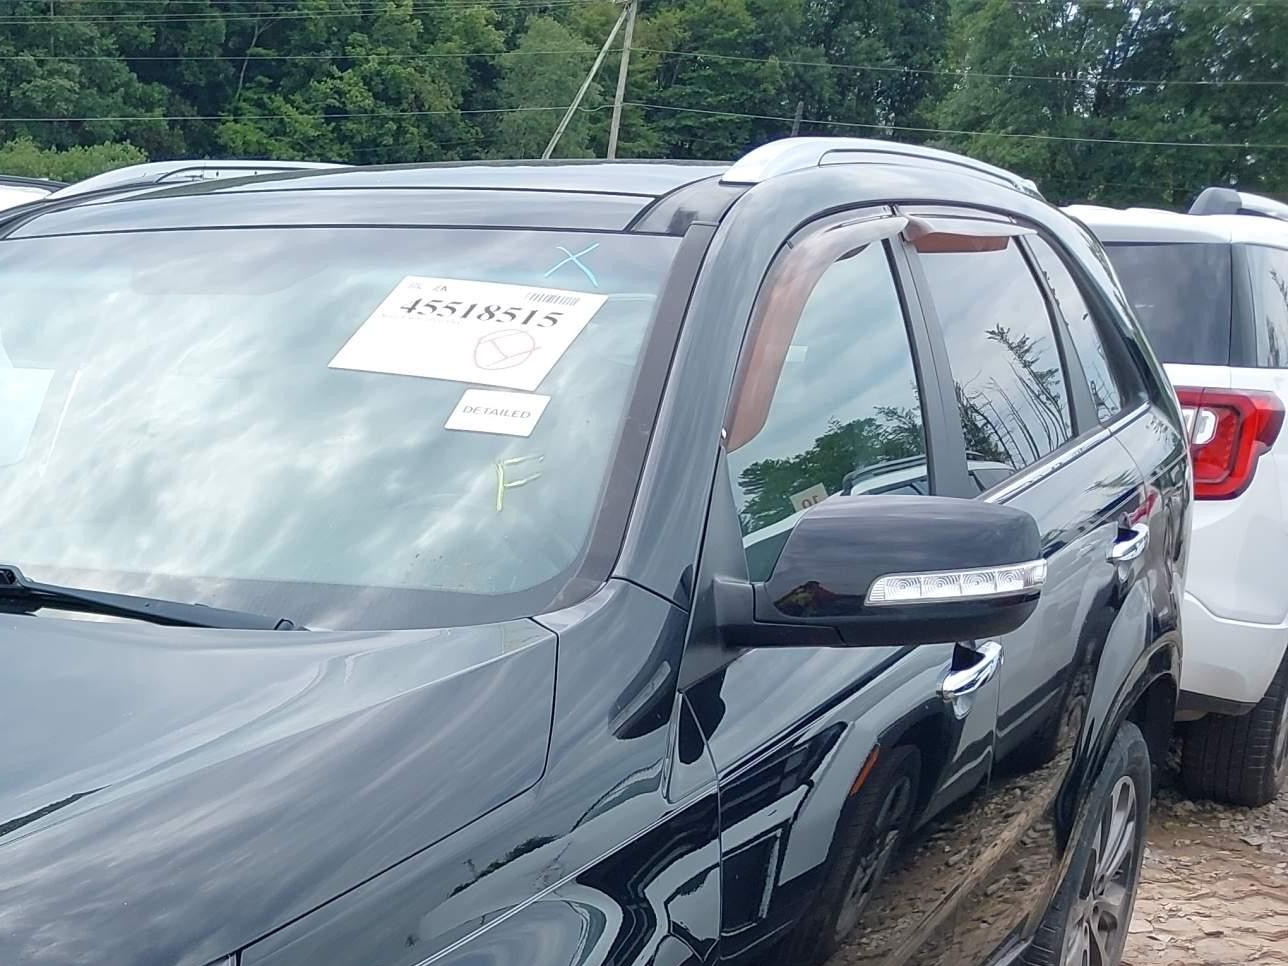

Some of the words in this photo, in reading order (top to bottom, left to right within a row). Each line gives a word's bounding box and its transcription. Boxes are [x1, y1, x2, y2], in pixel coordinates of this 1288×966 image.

[400, 298, 565, 328] 45518515
[462, 405, 532, 418] DETAILED
[495, 454, 545, 512] F
